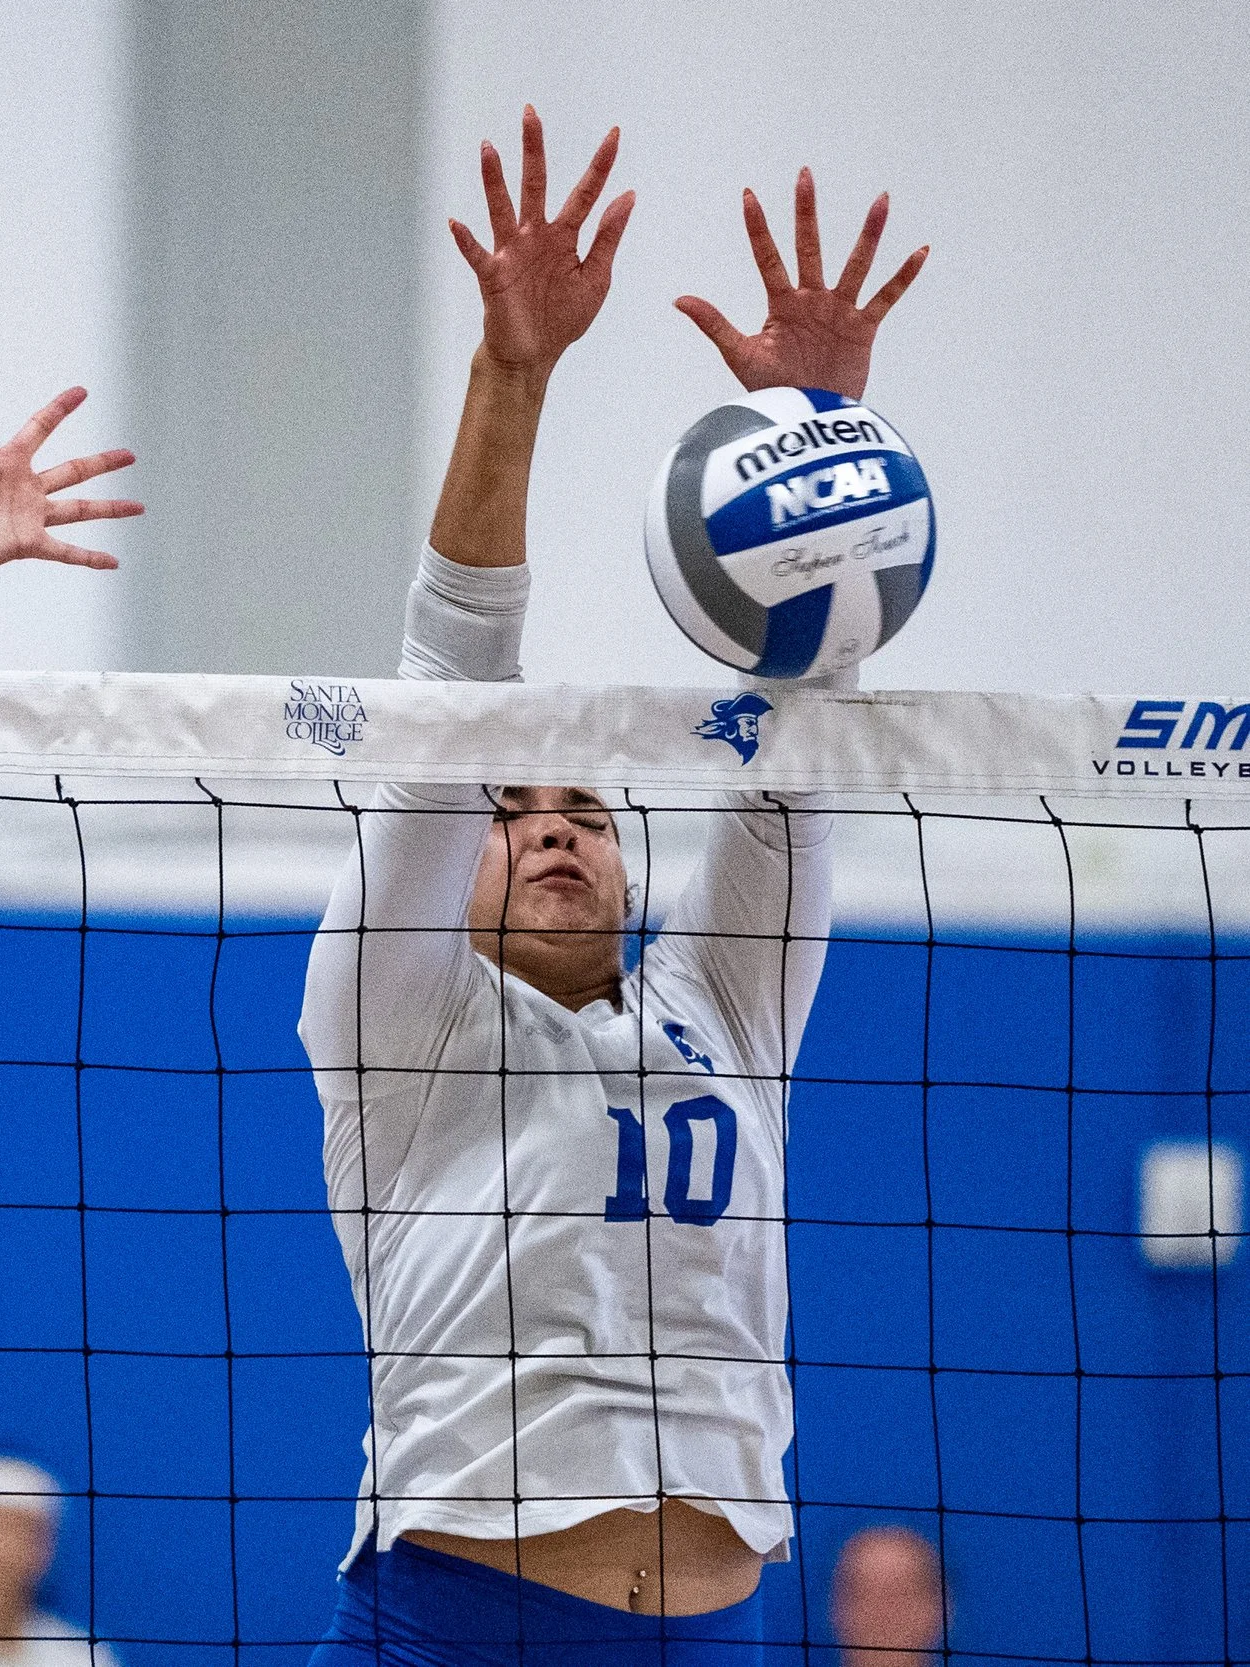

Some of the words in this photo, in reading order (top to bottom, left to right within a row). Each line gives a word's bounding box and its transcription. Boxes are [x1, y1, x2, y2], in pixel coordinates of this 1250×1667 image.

[734, 419, 884, 481] molten
[766, 457, 891, 527] NCAA
[283, 702, 369, 722] MONICA
[290, 680, 362, 702] SANTA
[286, 721, 363, 756] COLLEGE
[604, 1095, 737, 1226] 10
